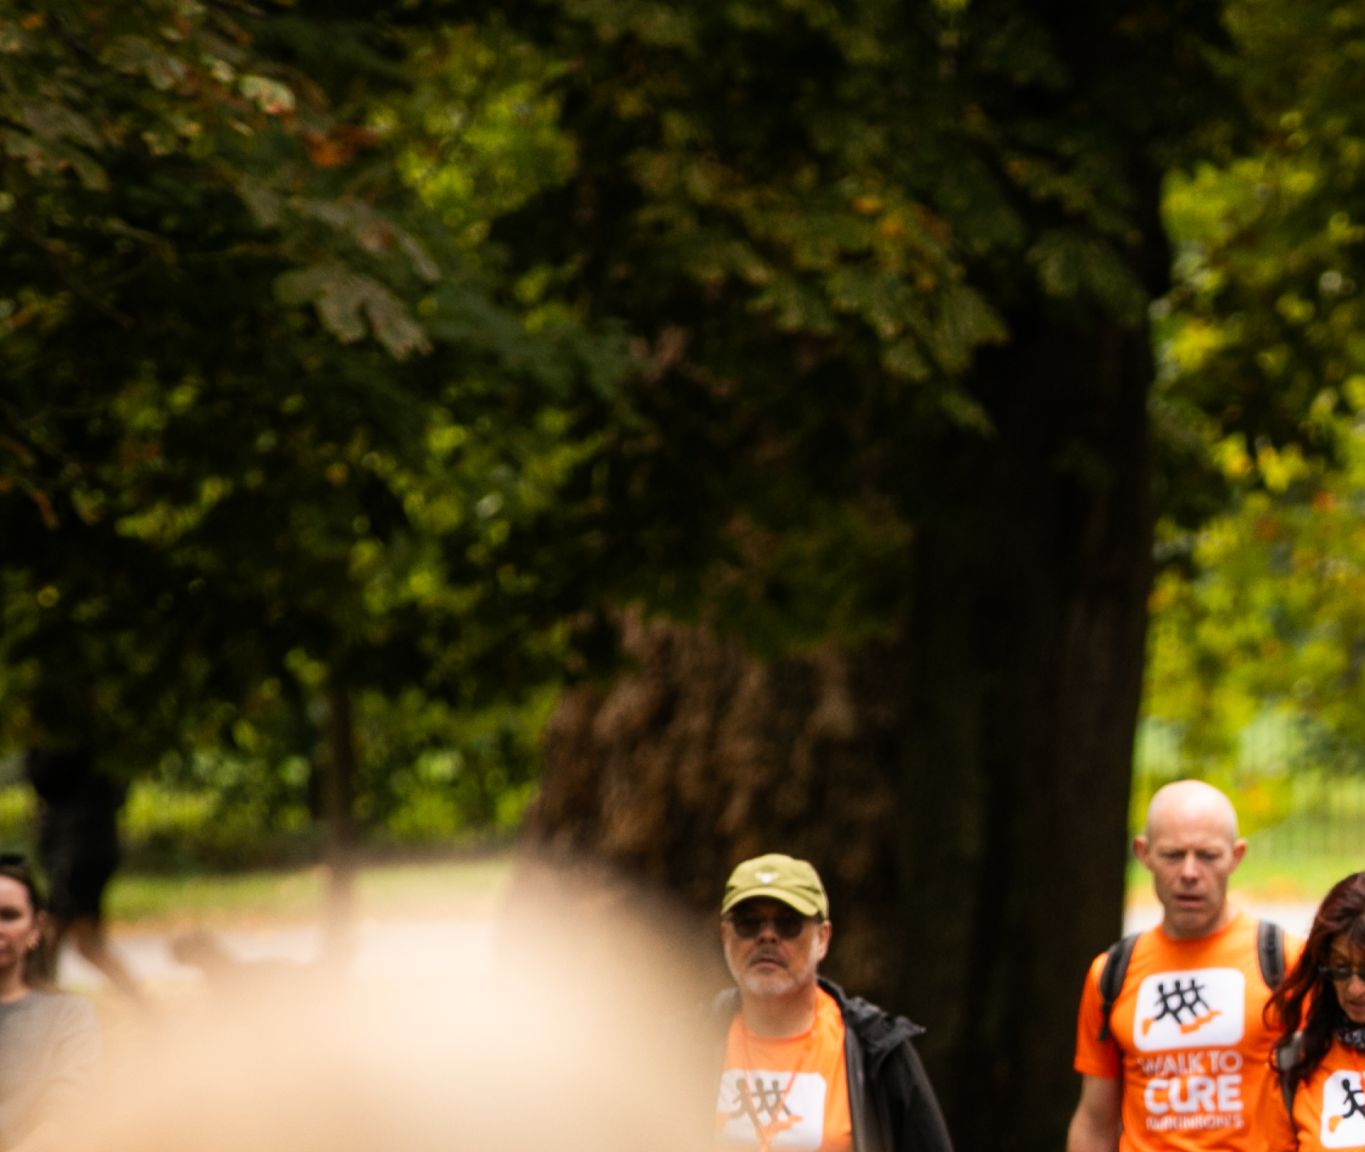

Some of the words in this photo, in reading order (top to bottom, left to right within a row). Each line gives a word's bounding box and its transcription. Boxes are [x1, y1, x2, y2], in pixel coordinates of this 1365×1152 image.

[1137, 1051, 1206, 1076] WALK
[1208, 1049, 1243, 1073] TO
[1143, 1074, 1243, 1116] CURE
